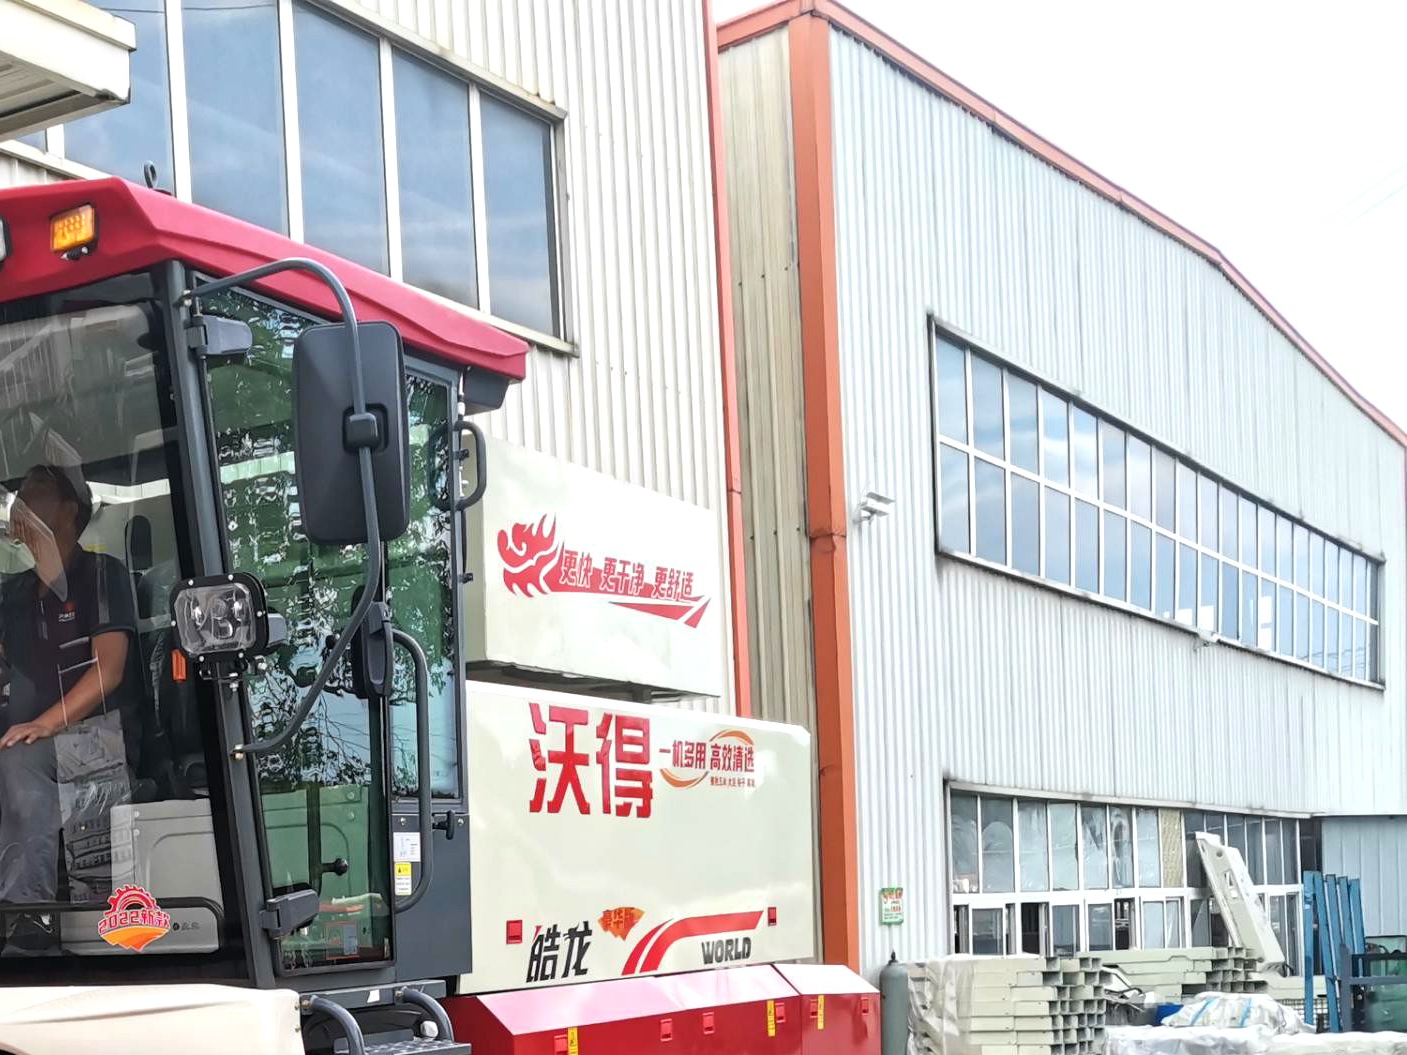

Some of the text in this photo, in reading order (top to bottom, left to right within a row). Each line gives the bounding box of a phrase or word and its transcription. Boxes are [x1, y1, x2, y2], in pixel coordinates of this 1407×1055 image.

[559, 550, 694, 602] 更快 更干净 更舒适
[528, 702, 653, 818] 沃得
[658, 740, 706, 769] 一机多用
[526, 920, 592, 983] 皓龙
[701, 936, 752, 965] WORLD
